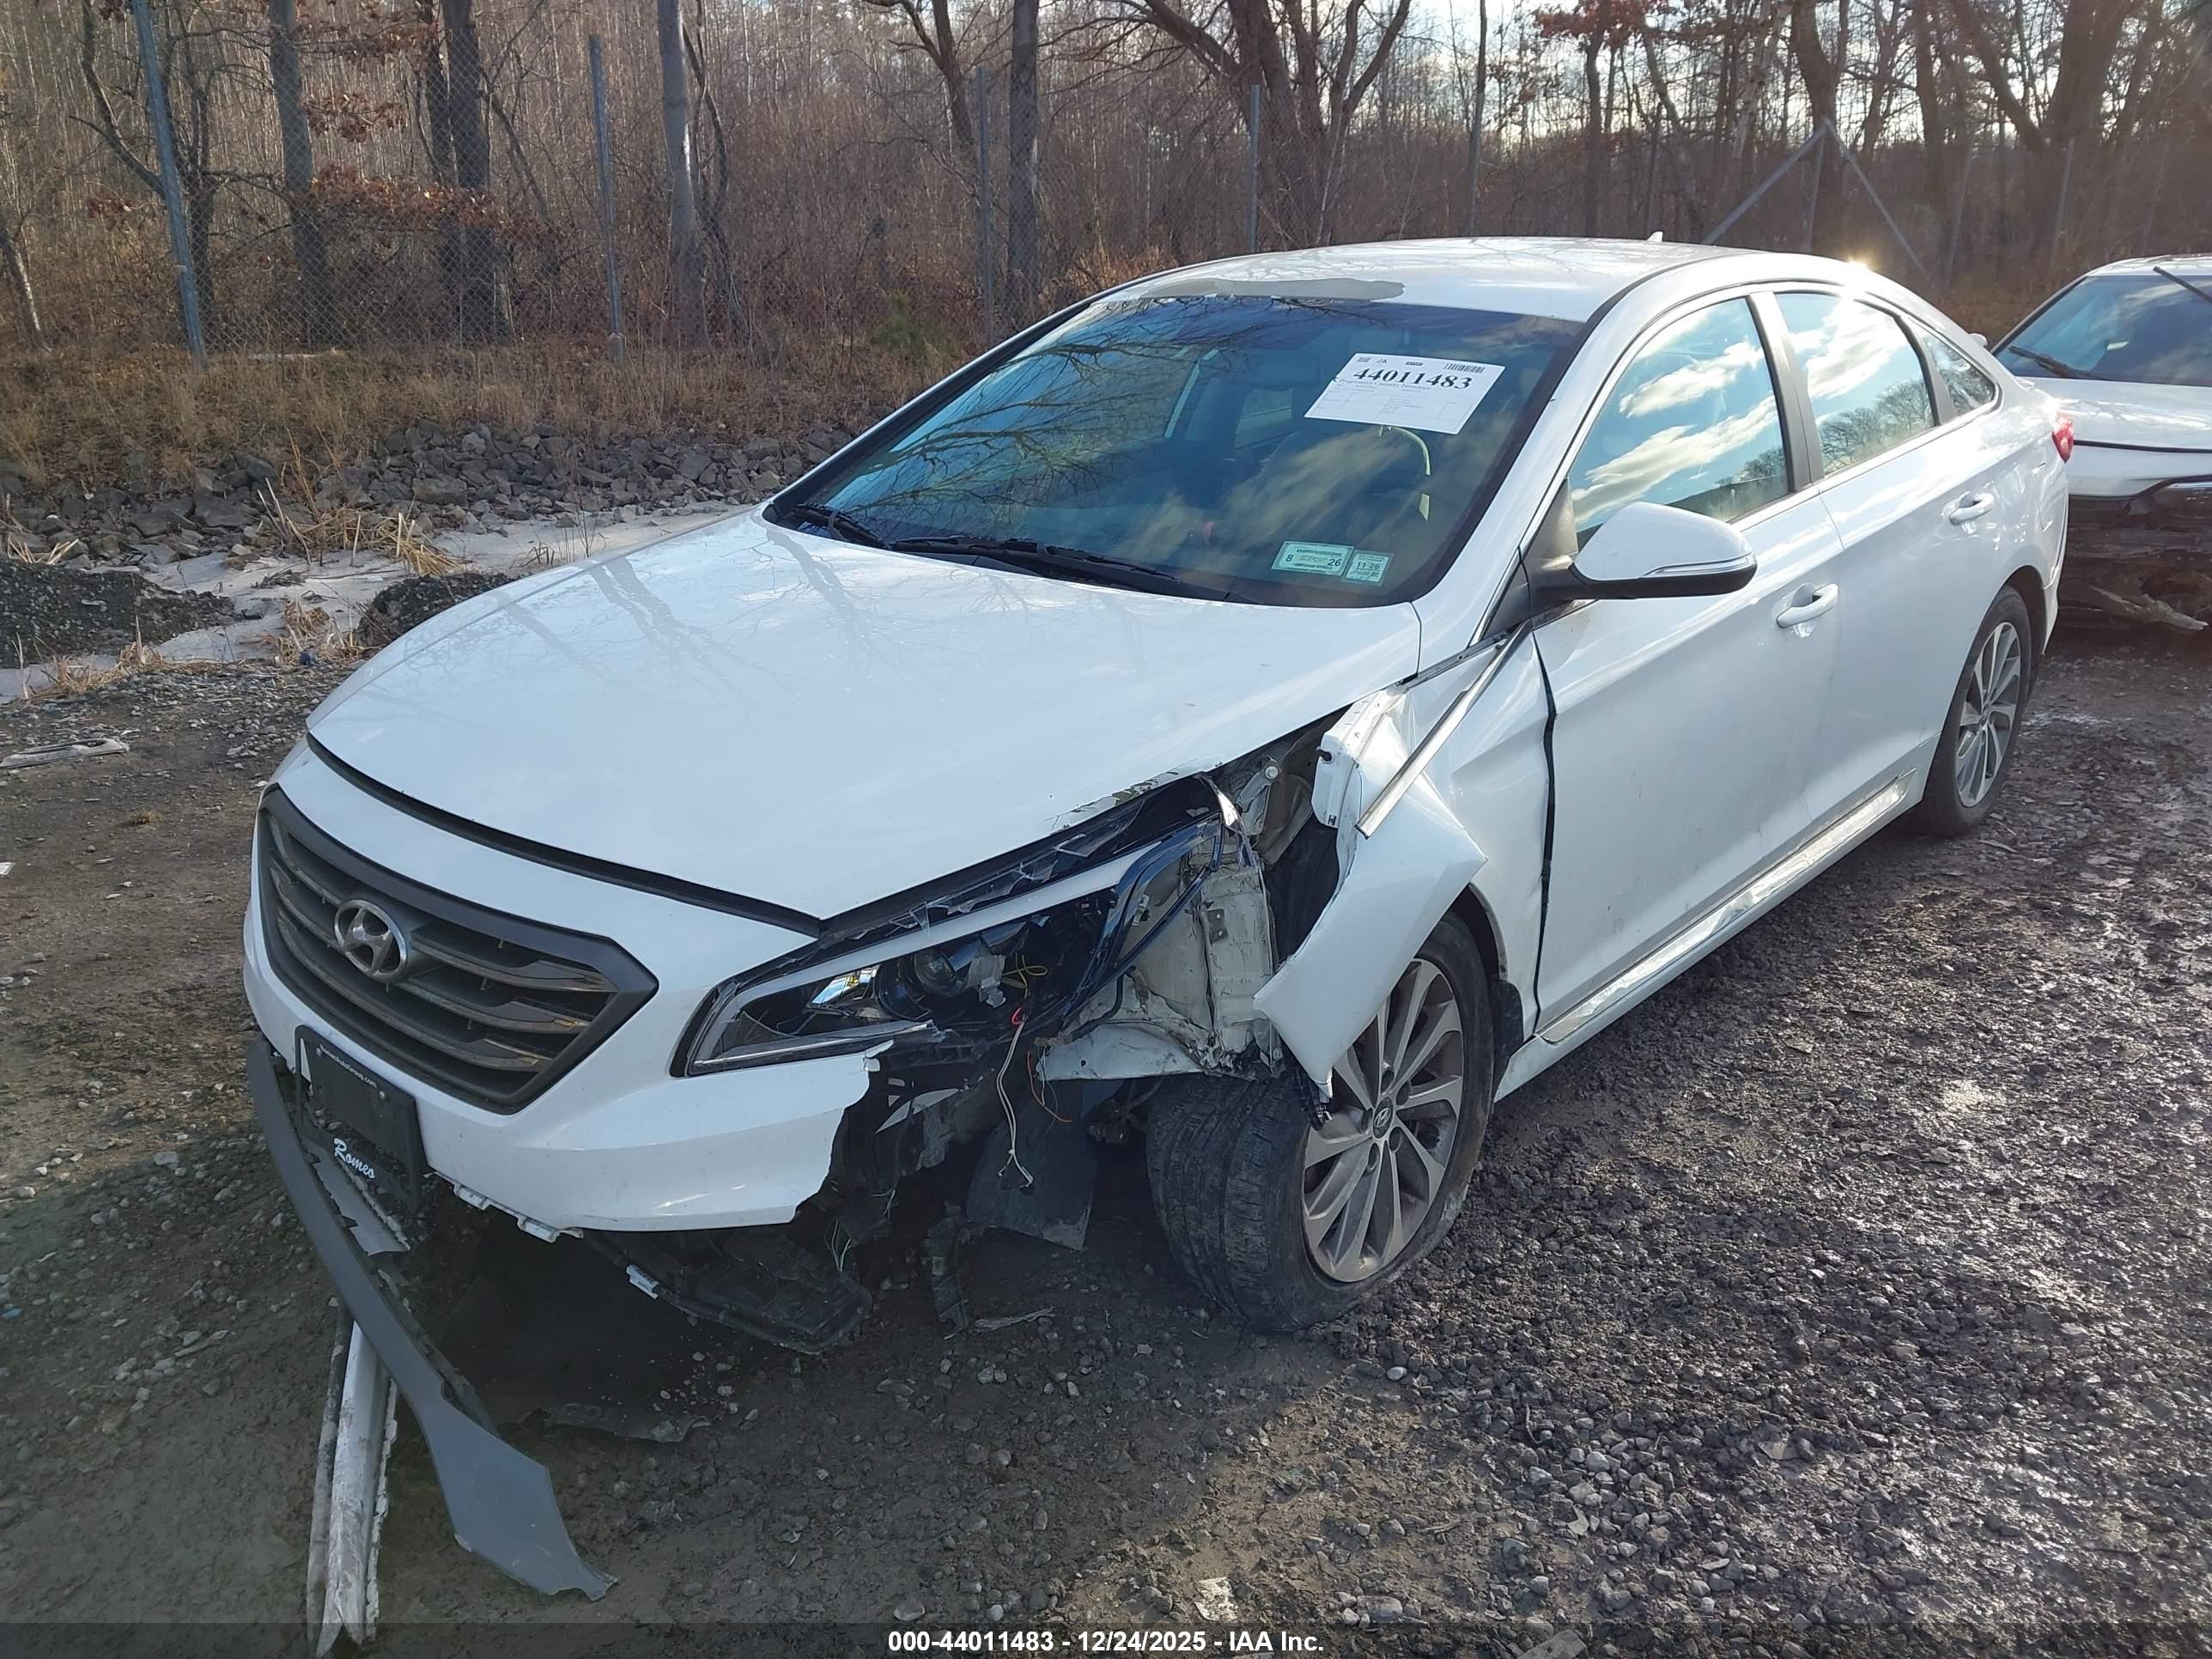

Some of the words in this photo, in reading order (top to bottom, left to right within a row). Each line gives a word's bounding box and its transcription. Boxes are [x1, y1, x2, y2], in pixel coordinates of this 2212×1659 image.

[1353, 368, 1472, 389] 44011483
[1327, 558, 1341, 567] 26
[333, 1138, 376, 1180] Romeo
